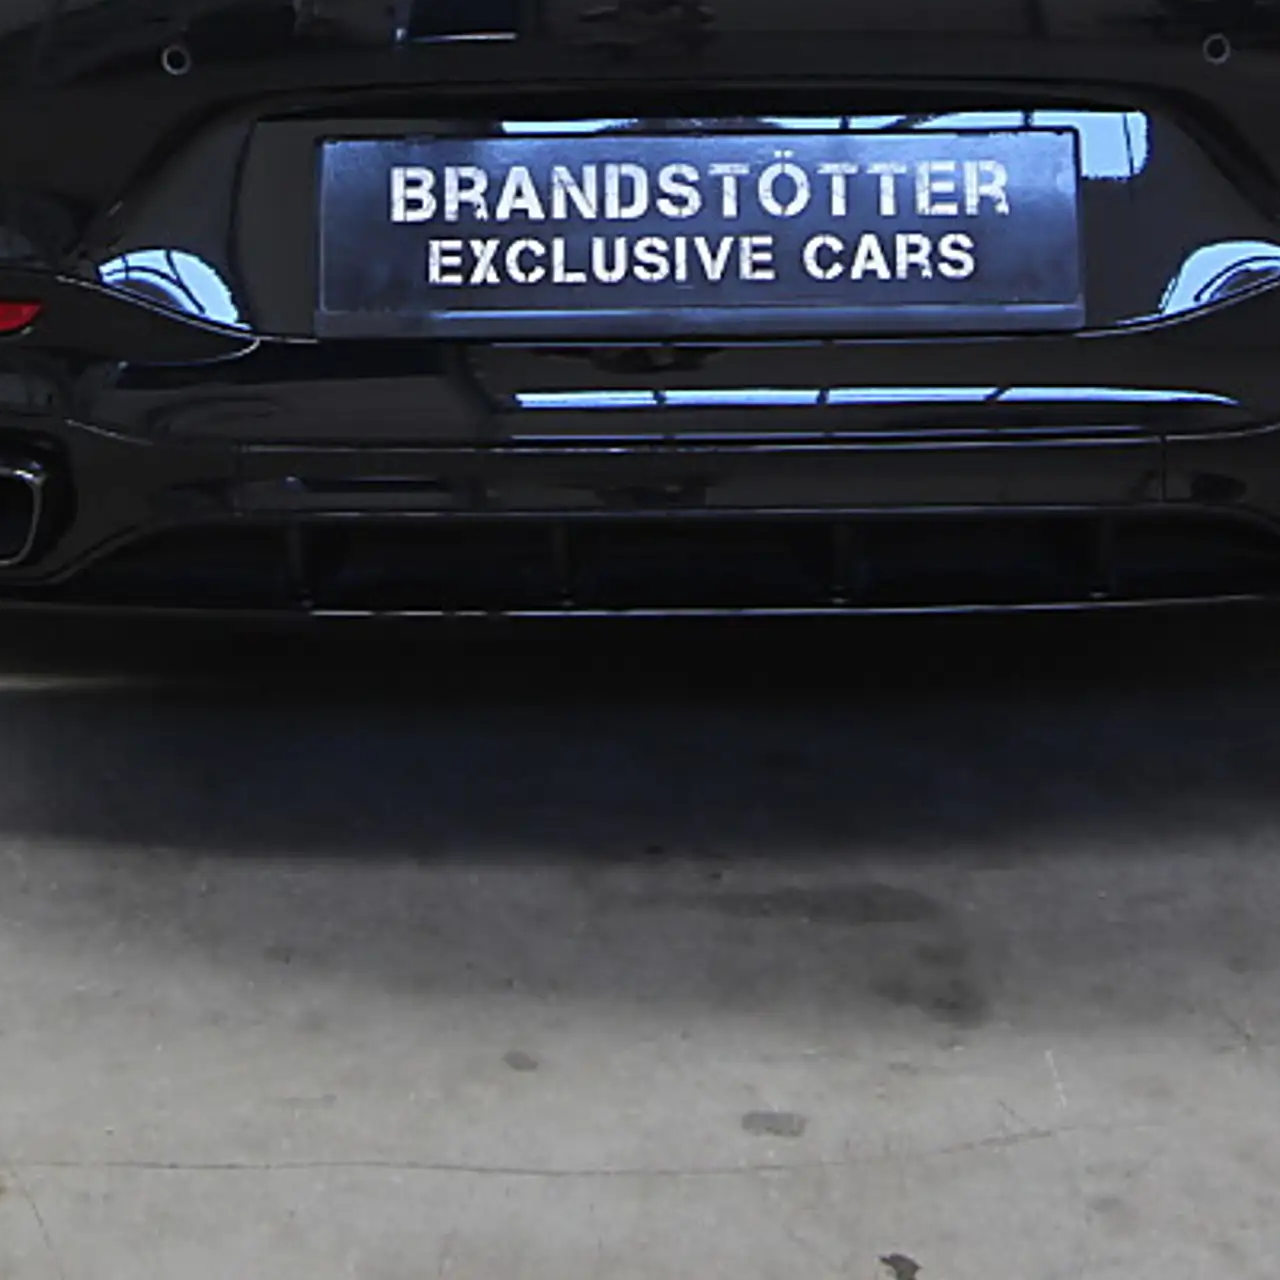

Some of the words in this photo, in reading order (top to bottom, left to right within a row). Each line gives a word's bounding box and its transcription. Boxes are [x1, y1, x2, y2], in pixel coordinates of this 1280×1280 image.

[389, 151, 1010, 223] BRANDSTÖTTER
[427, 235, 775, 285] EXCLUSIVE
[803, 233, 976, 281] CARS
